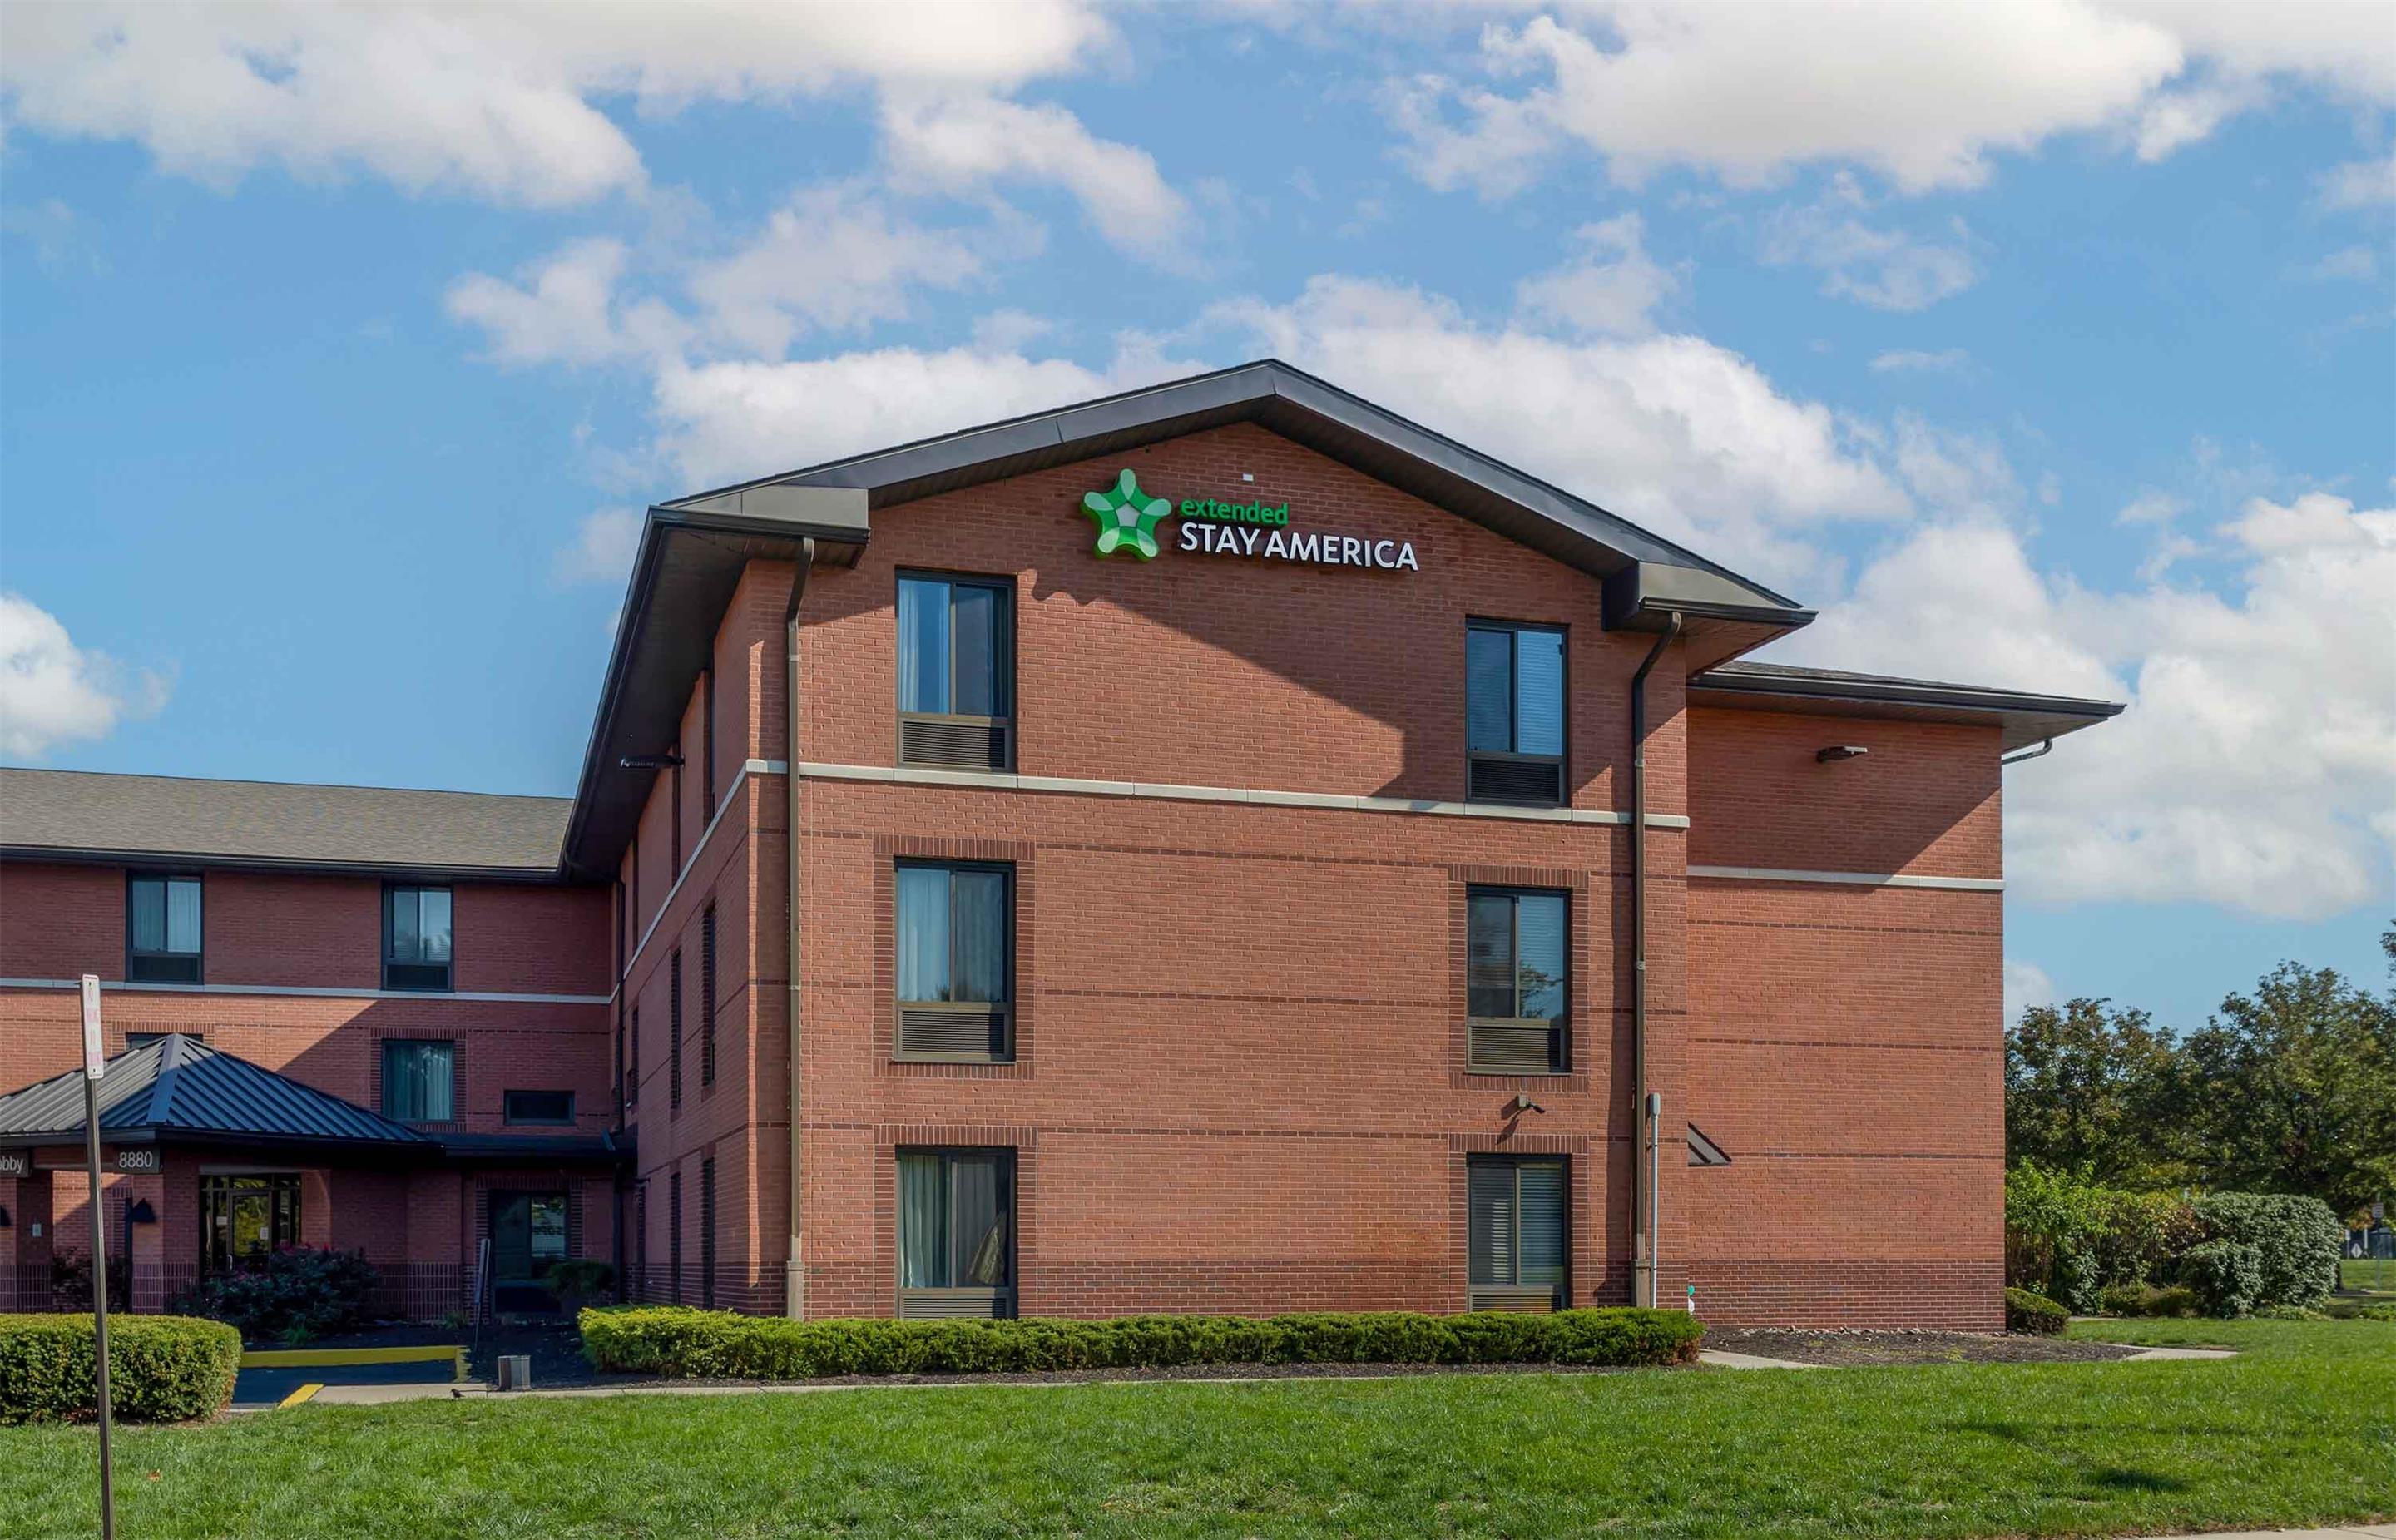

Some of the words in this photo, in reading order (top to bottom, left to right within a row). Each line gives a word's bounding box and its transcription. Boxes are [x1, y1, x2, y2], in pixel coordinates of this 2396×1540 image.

[1181, 498, 1289, 525] extended
[1181, 522, 1260, 555] STAY
[1264, 531, 1419, 571] AMERICA
[118, 1151, 153, 1168] 8880
